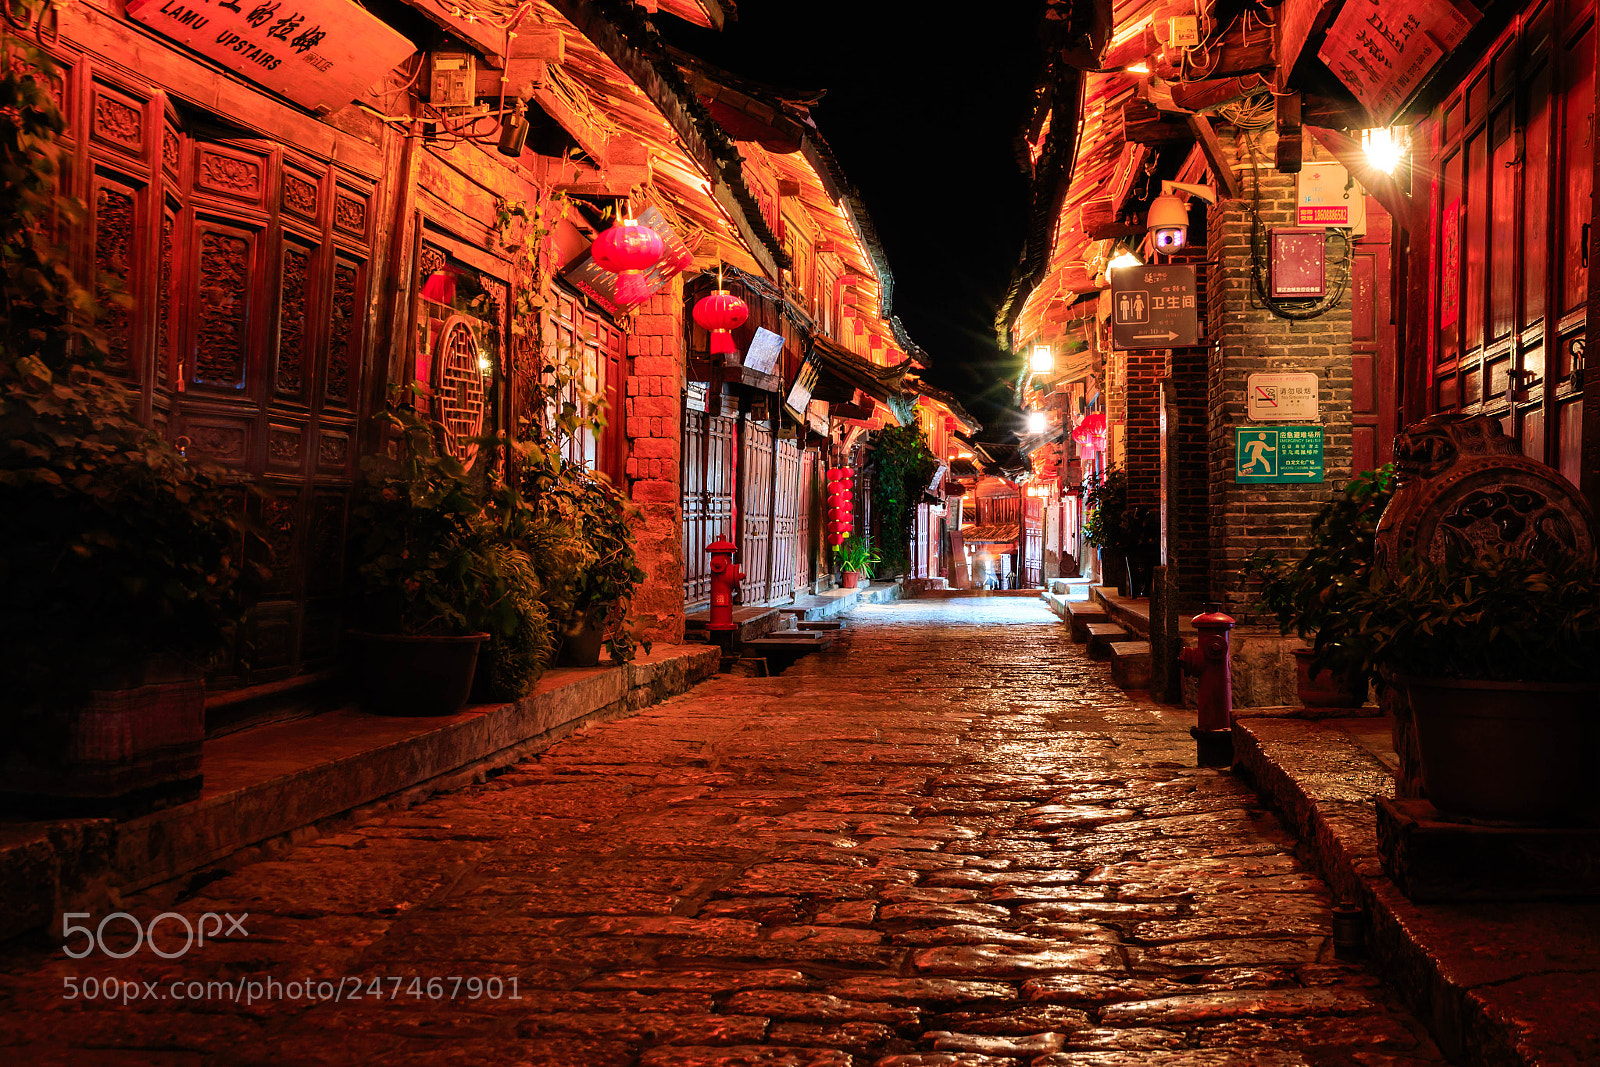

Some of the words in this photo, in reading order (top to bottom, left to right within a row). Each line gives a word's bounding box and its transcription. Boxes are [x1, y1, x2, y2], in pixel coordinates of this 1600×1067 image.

[159, 0, 208, 30] LAMU
[215, 30, 283, 71] UPSTAIRS
[1152, 295, 1195, 310] 卫生间
